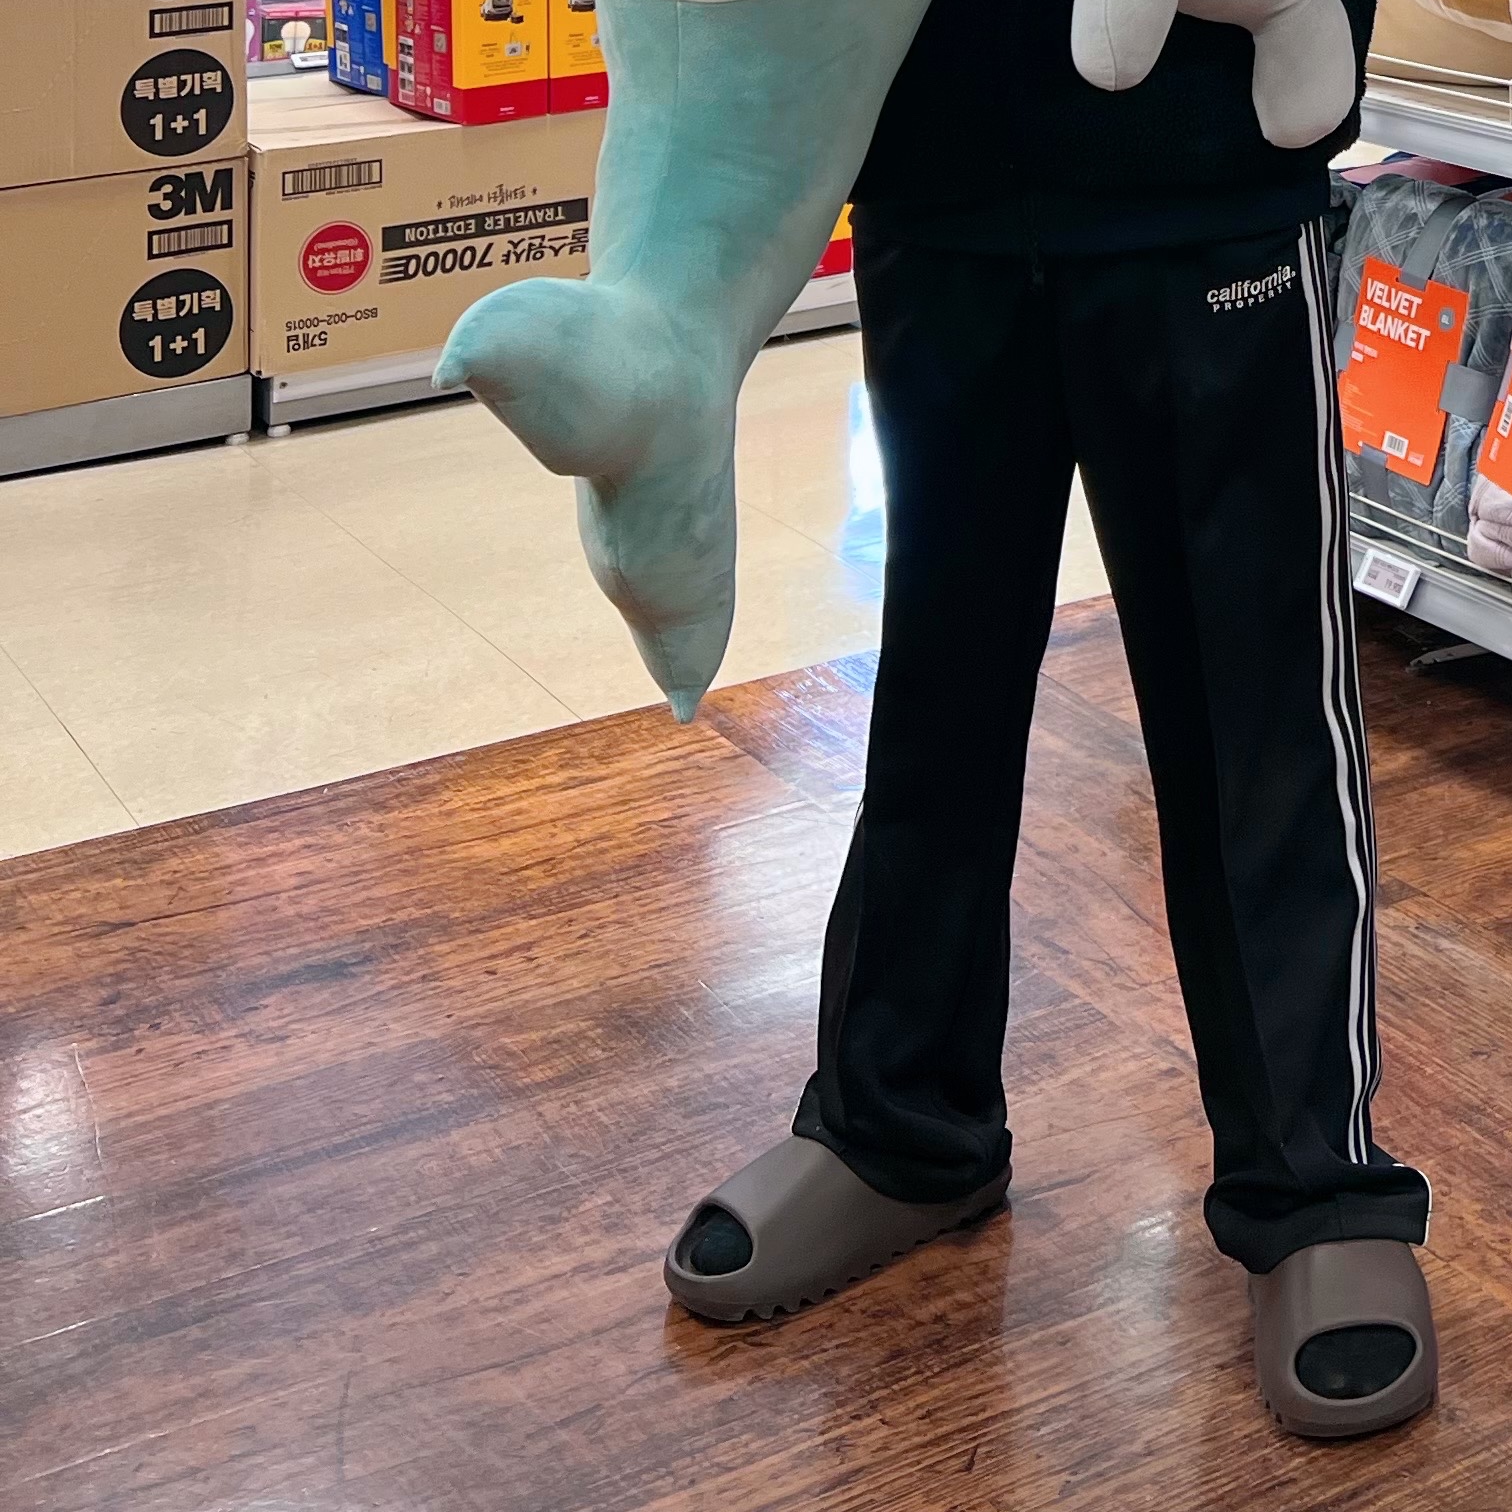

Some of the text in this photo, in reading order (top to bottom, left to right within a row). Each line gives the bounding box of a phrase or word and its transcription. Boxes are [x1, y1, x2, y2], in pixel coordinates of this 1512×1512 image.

[133, 70, 223, 101] 특별기획
[149, 108, 208, 141] 1+1
[147, 168, 234, 221] 3M
[404, 206, 566, 243] TRAVELER EDITION
[402, 241, 494, 281] 70000
[132, 288, 222, 324] 특별기획
[1212, 281, 1292, 313] PROPERTY
[1365, 277, 1423, 319] VELVET
[148, 326, 207, 363] 1+1
[286, 330, 329, 354] 5개입
[1358, 304, 1431, 352] BLANKET
